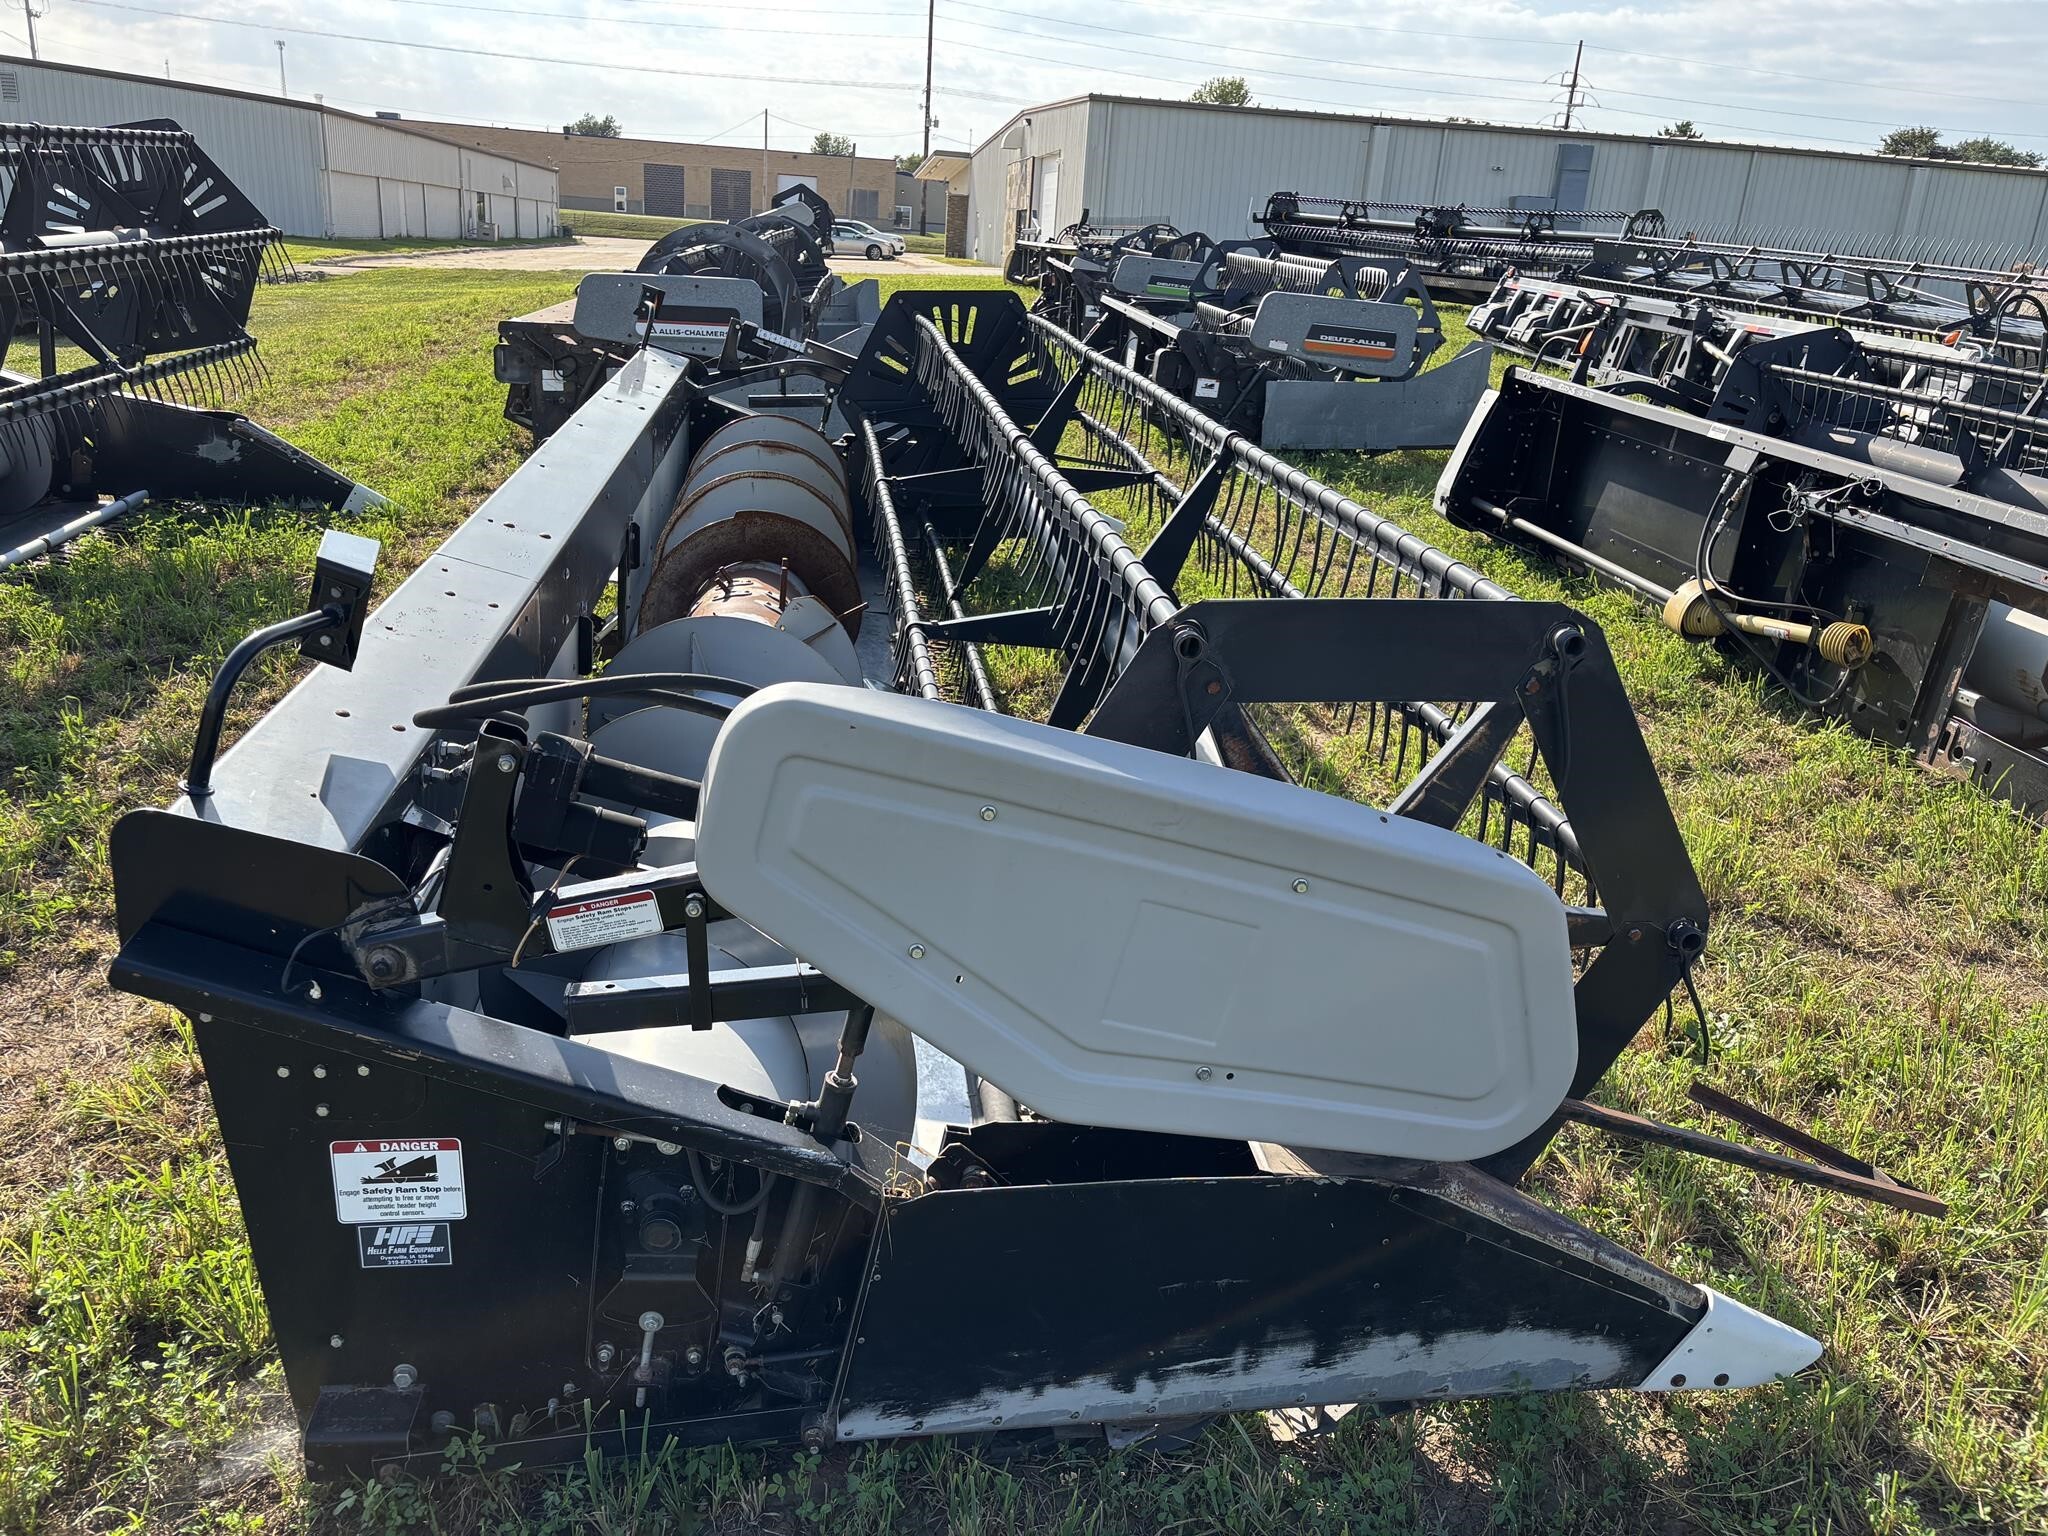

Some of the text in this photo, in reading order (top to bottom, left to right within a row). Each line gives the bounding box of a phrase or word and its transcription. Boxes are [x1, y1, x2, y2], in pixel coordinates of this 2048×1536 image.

[590, 899, 619, 910] DANGER
[574, 912, 598, 920] Safety
[597, 909, 613, 917] Ram
[613, 906, 632, 914] Stops
[380, 1141, 439, 1152] DANGER
[362, 1187, 393, 1196] Safety
[419, 1186, 442, 1194] Stop
[418, 1202, 437, 1210] height
[388, 1246, 407, 1254] FARM
[409, 1245, 445, 1254] EQUIPMENT
